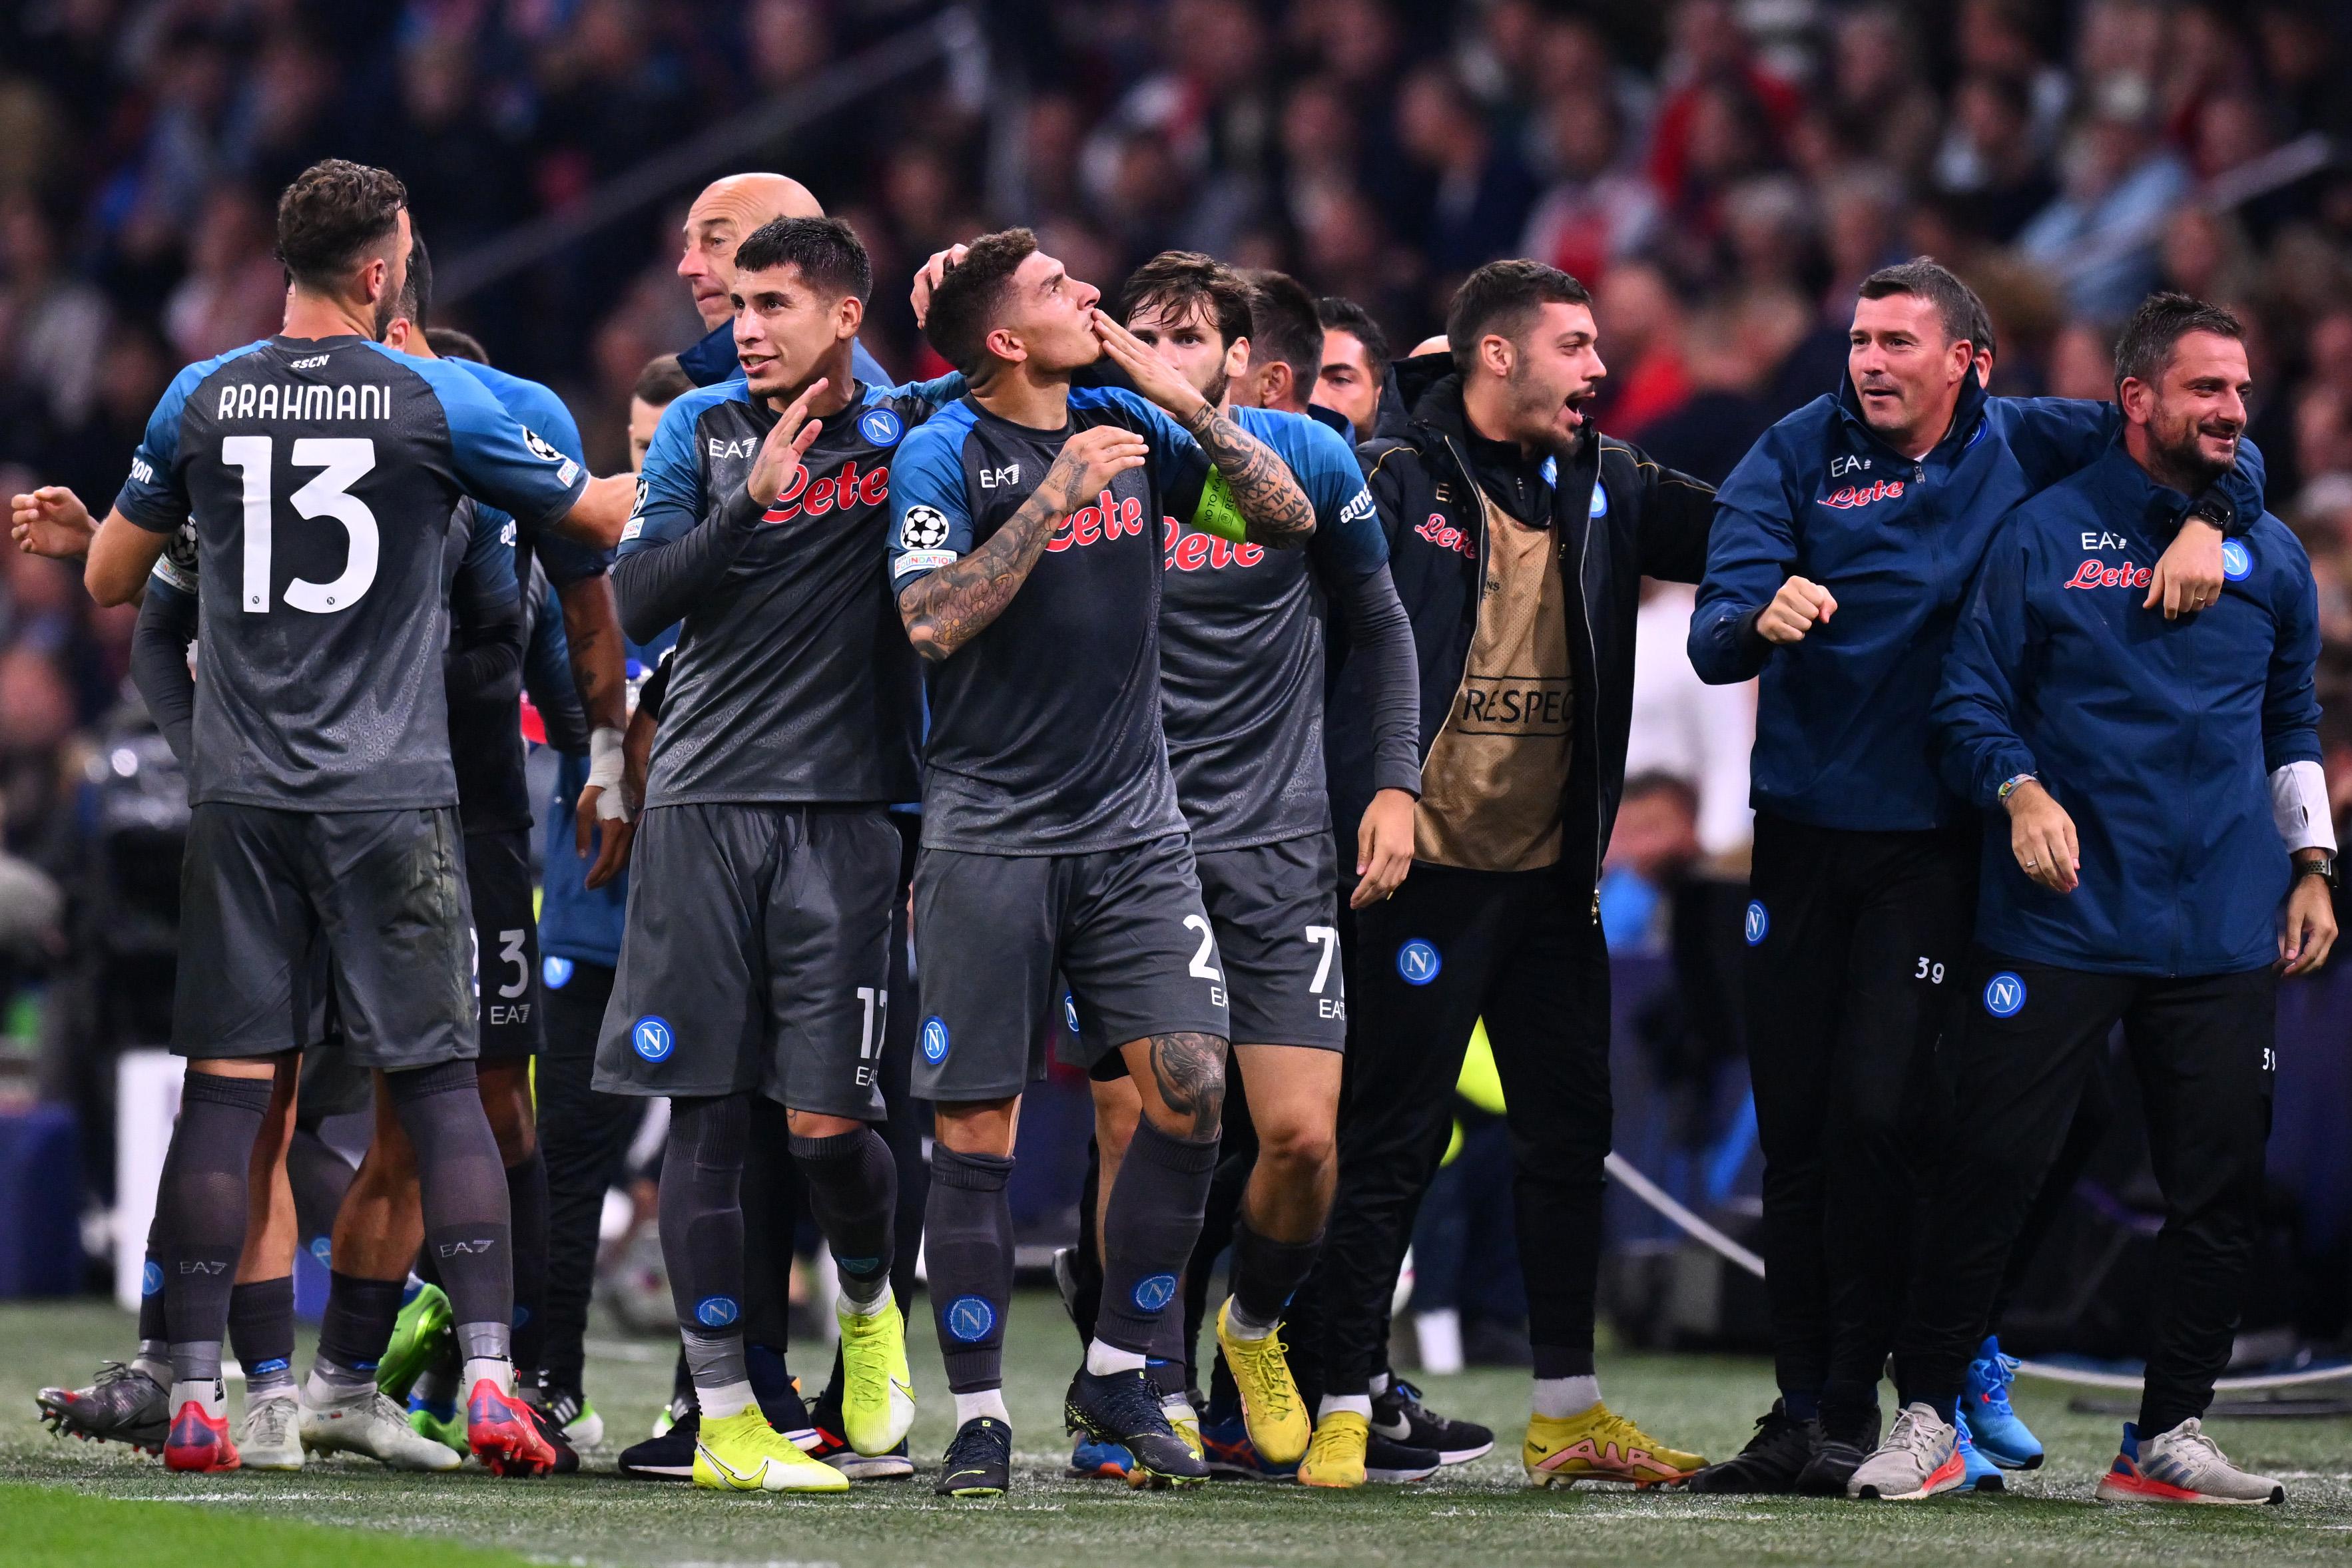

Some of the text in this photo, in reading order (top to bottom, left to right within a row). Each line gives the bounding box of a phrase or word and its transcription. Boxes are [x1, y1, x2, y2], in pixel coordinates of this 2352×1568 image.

[290, 355, 330, 368] SSCN
[218, 384, 390, 419] RRAHMANI
[709, 437, 757, 458] EA7
[980, 463, 1020, 488] EA7
[1817, 479, 1905, 509] Lete
[222, 436, 379, 613] 13
[2064, 559, 2152, 589] Lete
[498, 929, 529, 999] 3
[1182, 914, 1226, 985] 2
[1305, 925, 1345, 998] 7
[1914, 956, 1945, 984] 39
[490, 1003, 531, 1025] EA7
[440, 1240, 494, 1258] EA7
[180, 1261, 228, 1275] EA7
